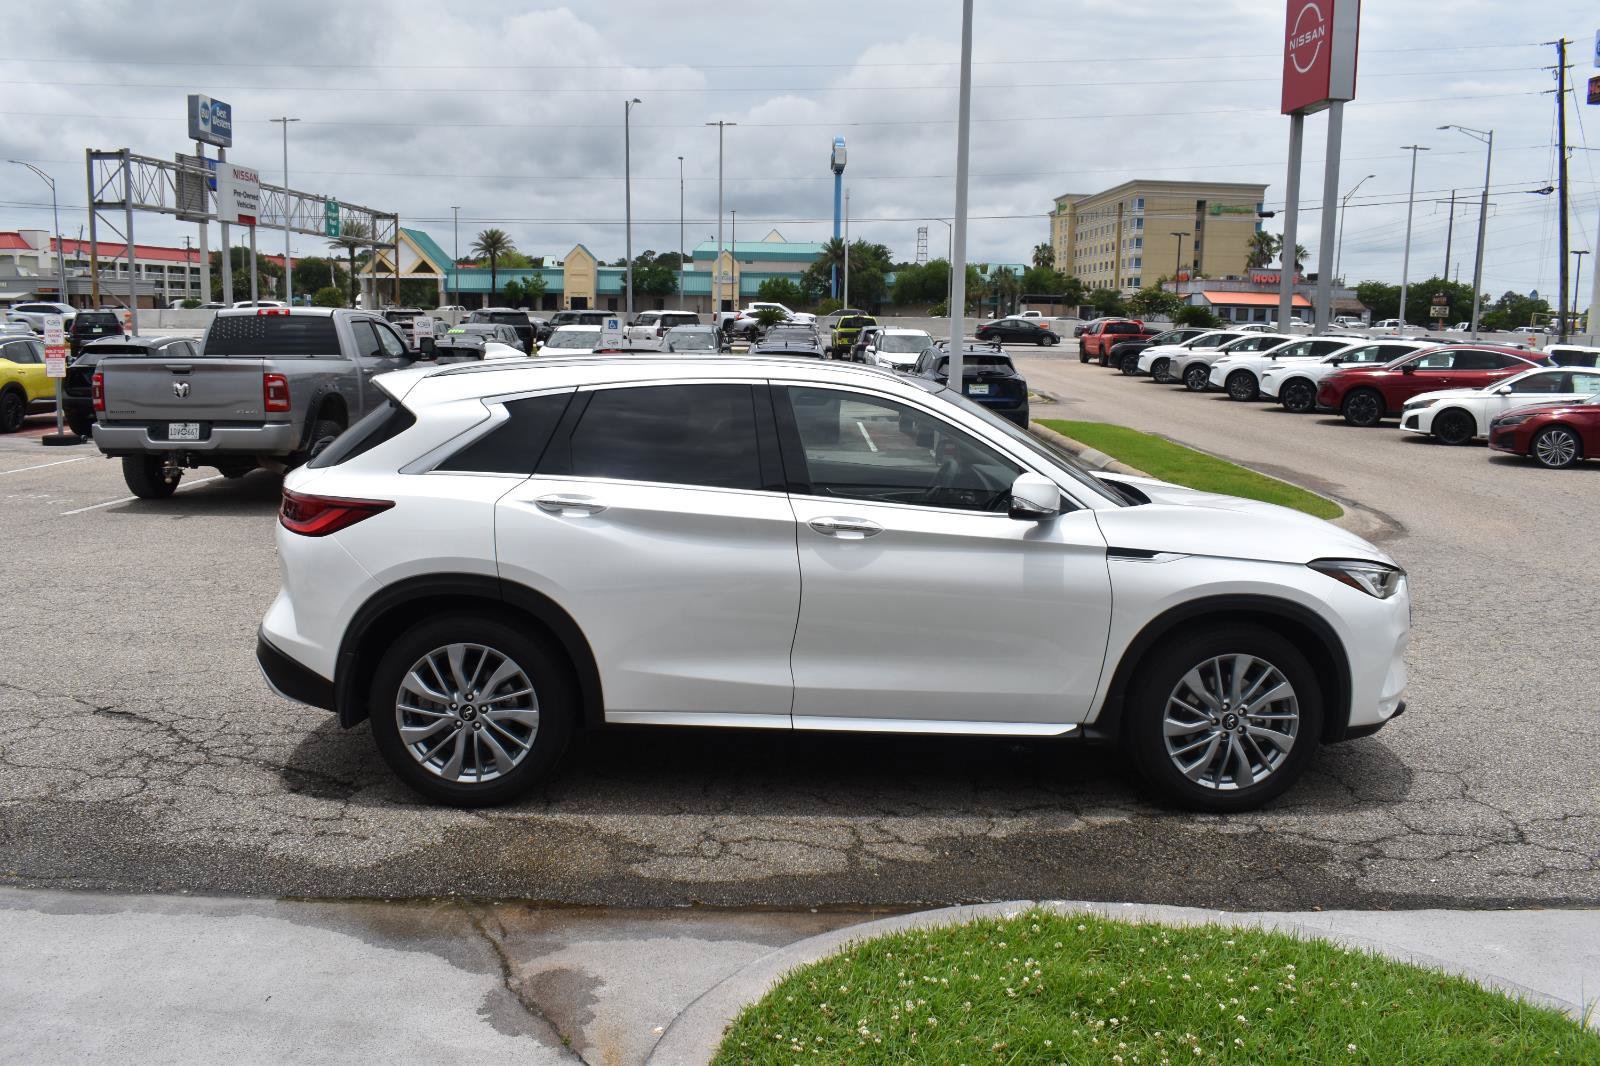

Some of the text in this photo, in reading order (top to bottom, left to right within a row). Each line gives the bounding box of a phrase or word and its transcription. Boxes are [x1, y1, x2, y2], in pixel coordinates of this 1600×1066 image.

[1289, 25, 1325, 51] NISSAN
[216, 108, 227, 119] Best
[212, 116, 231, 130] Western
[233, 169, 258, 184] NISSAN
[233, 189, 259, 201] Pre-Owned
[236, 200, 256, 211] Vehicles
